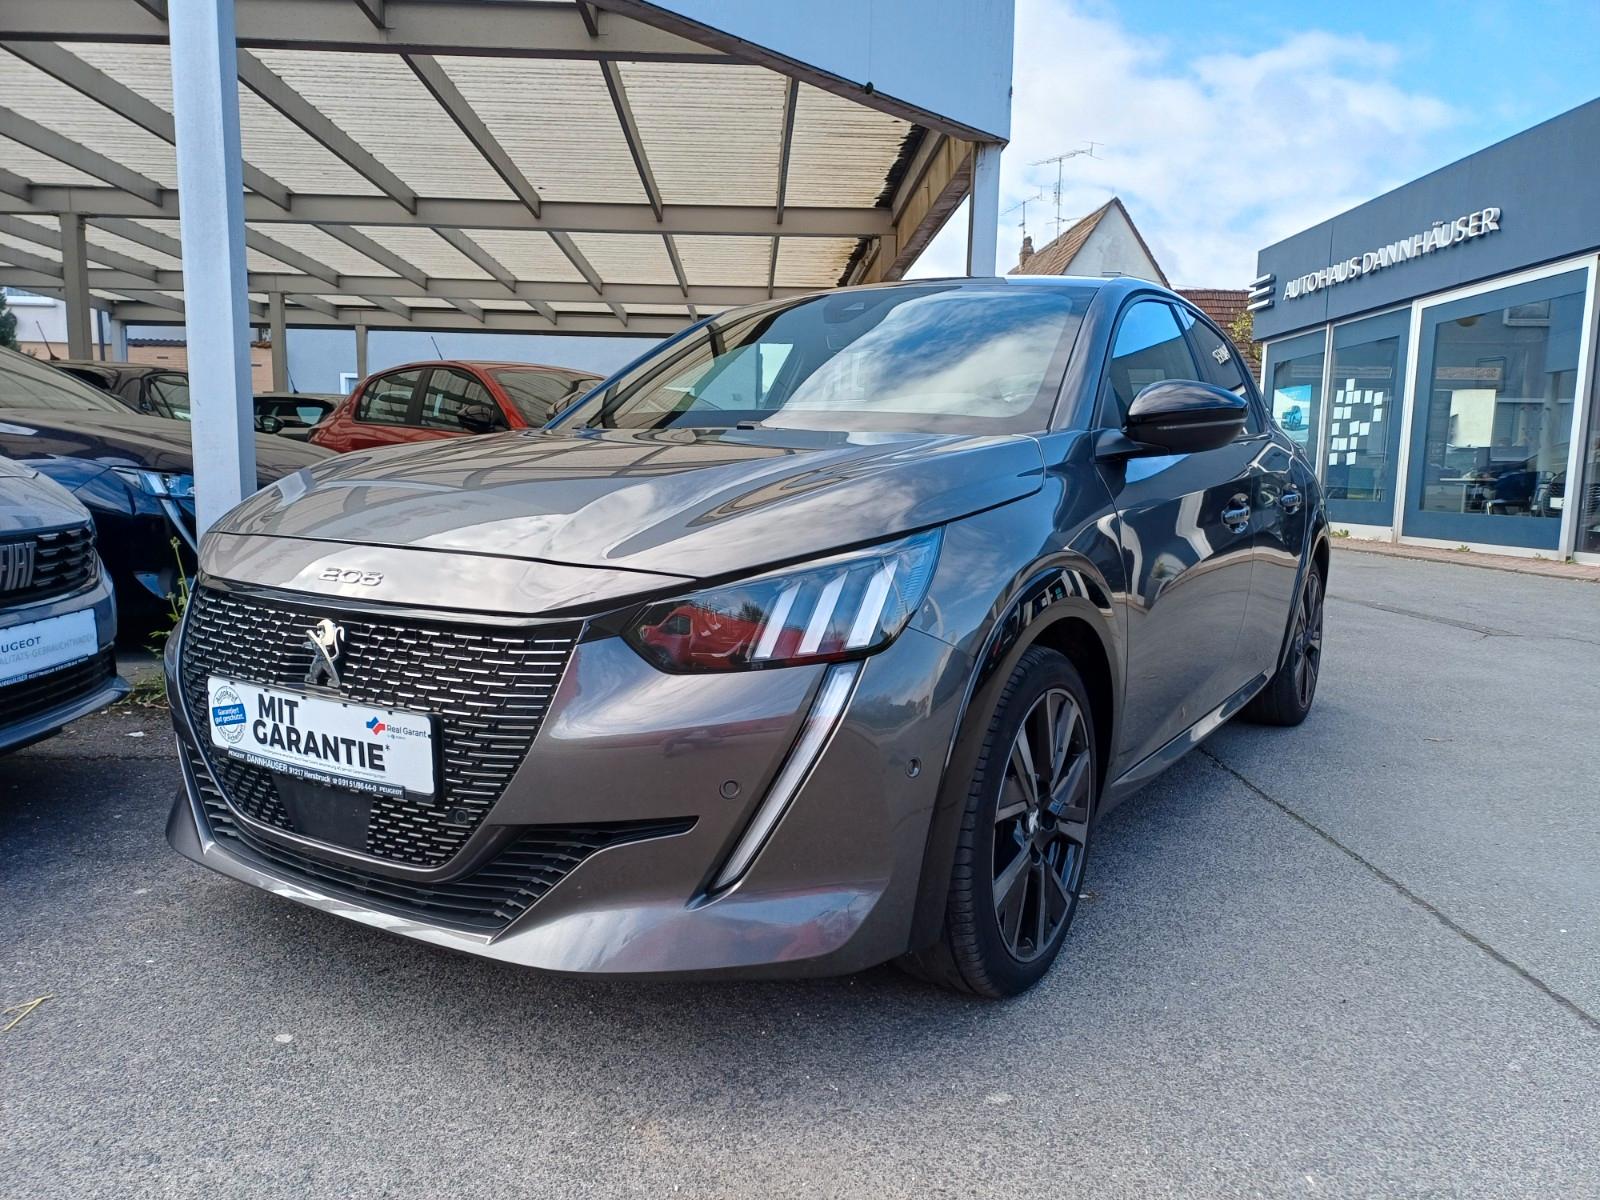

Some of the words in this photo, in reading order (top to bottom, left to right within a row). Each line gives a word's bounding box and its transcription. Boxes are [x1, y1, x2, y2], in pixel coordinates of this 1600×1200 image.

[1283, 256, 1362, 300] AUTOHAUS
[1362, 207, 1501, 274] DANNHÄUSER
[318, 567, 384, 587] 208
[0, 635, 41, 654] UGEOT
[258, 693, 299, 726] MIT
[386, 724, 402, 734] Real
[402, 727, 427, 738] Garant
[304, 769, 331, 783] Hersbruck
